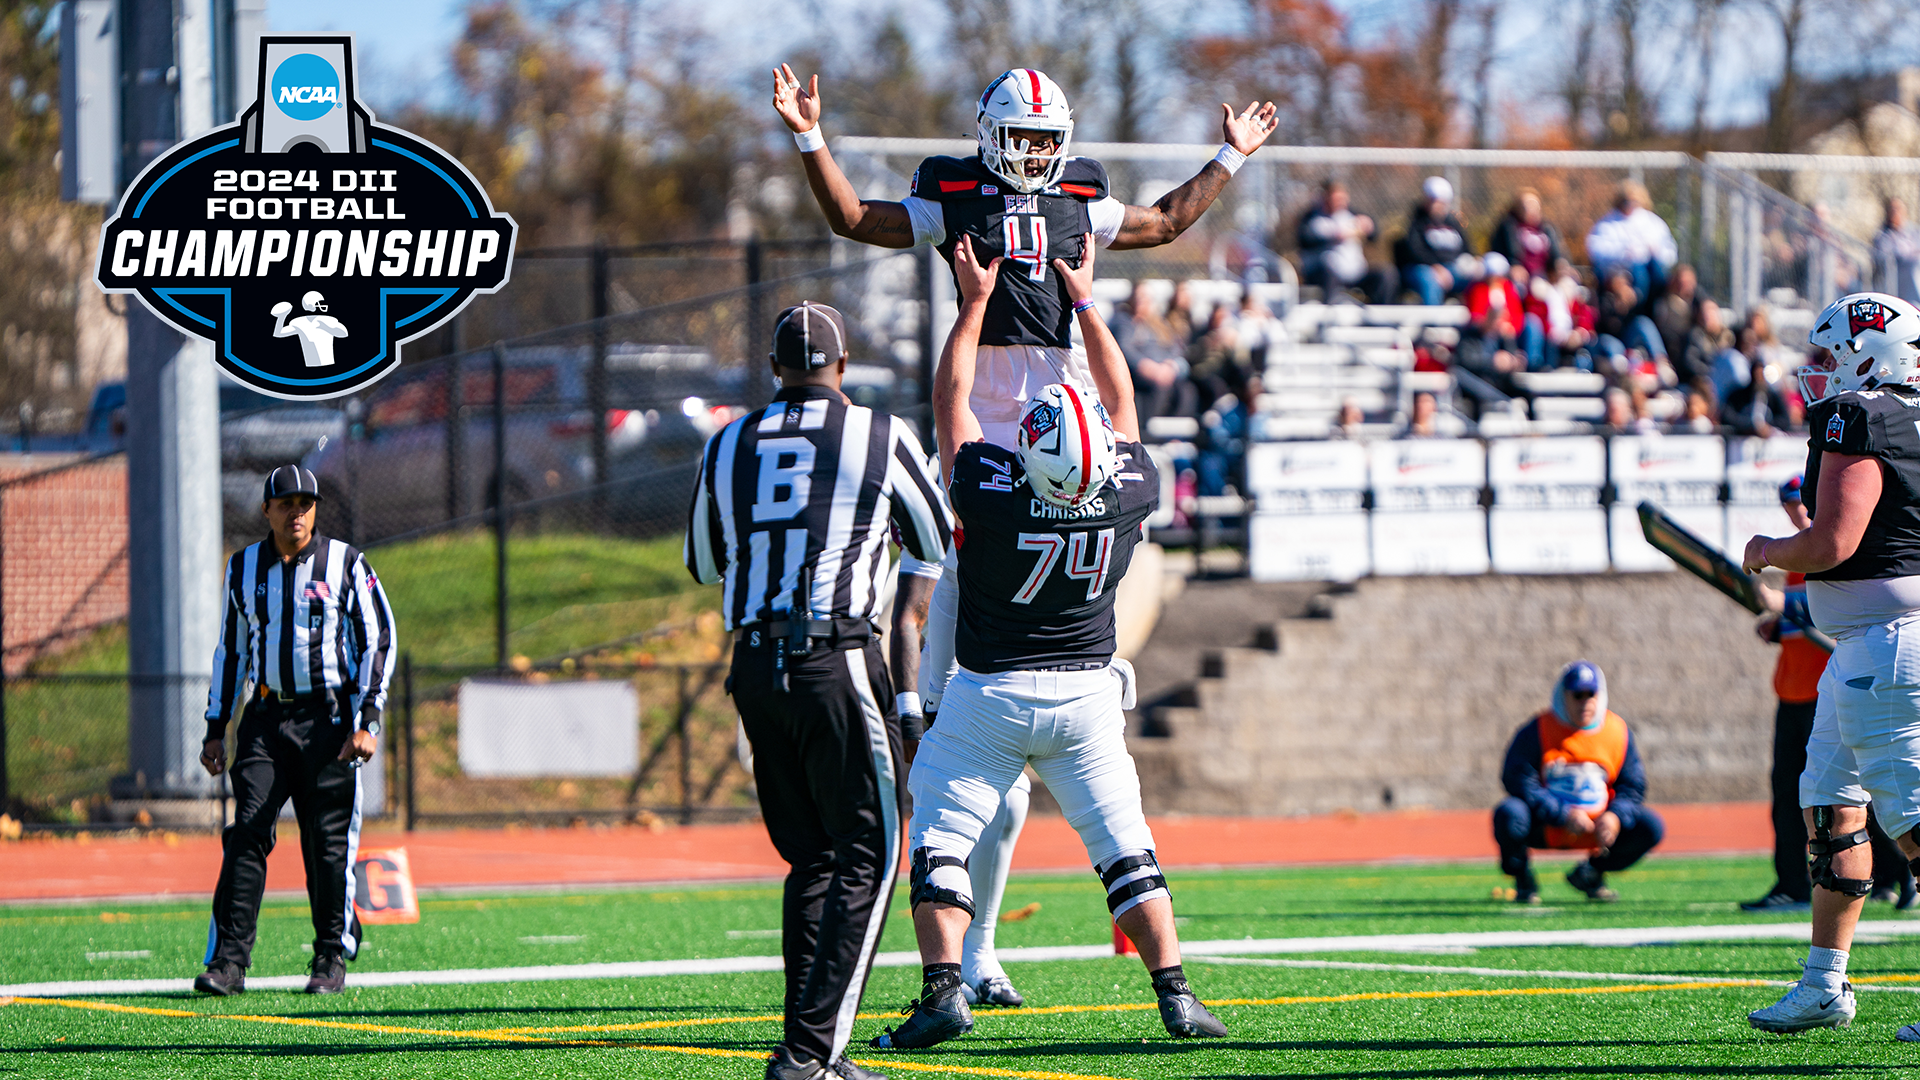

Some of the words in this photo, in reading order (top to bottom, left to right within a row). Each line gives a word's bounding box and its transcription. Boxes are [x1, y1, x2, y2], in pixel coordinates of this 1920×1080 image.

[1003, 194, 1039, 214] ESU
[1003, 215, 1048, 282] 4
[752, 436, 817, 524] B
[979, 456, 1013, 493] 74
[1011, 528, 1115, 605] 74
[311, 615, 323, 634] F
[354, 858, 405, 912] G
